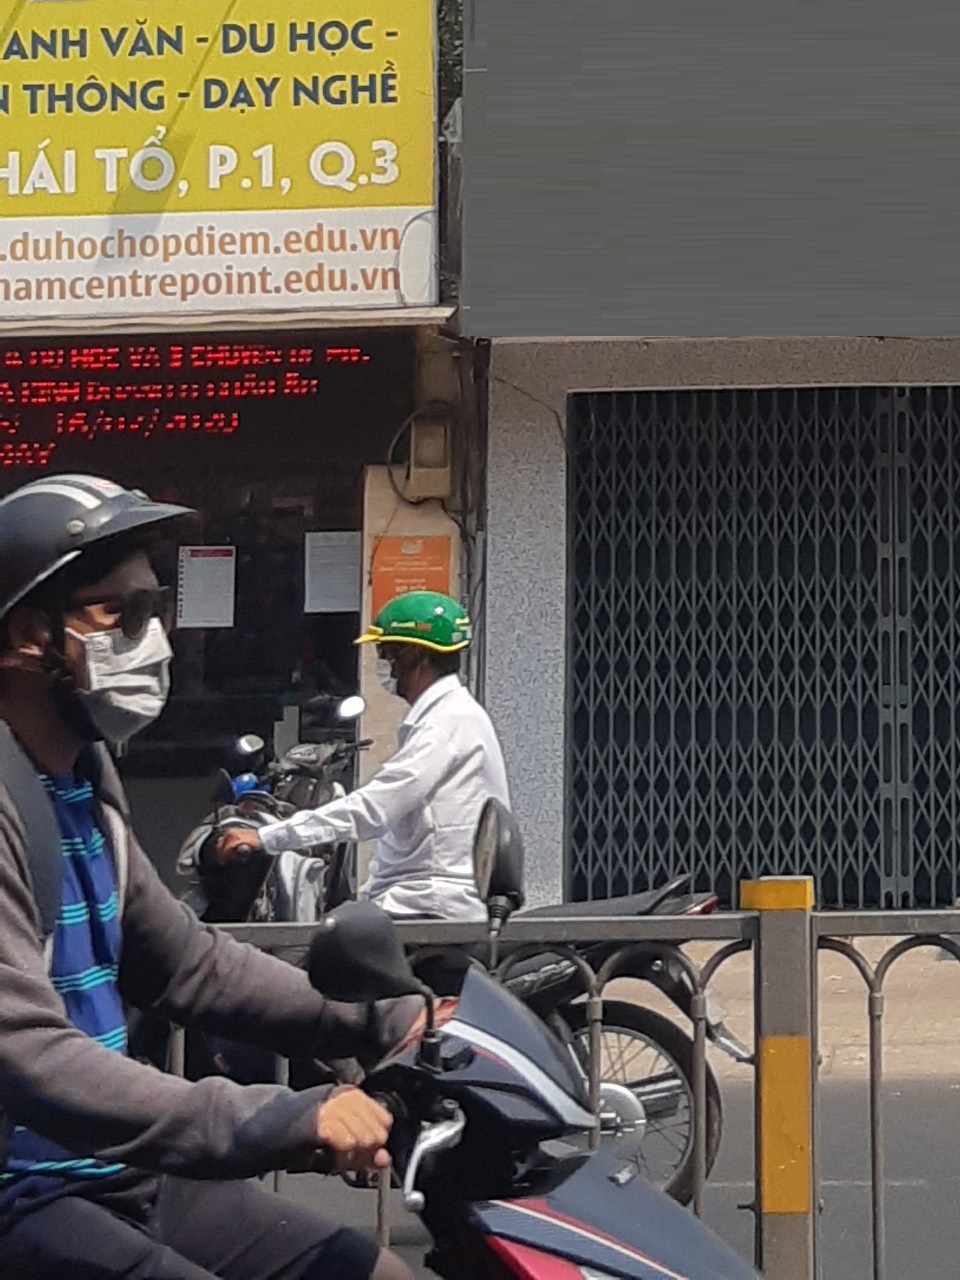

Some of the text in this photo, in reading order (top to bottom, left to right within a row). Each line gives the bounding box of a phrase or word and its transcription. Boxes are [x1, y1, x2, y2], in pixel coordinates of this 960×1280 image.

[3, 28, 88, 60] ANH
[100, 17, 184, 58] VĂN
[222, 22, 275, 55] DU
[289, 19, 374, 57] HỌC
[22, 74, 165, 115] THÔNG
[203, 77, 281, 115] DẠY
[292, 59, 398, 107] NGHỀ
[94, 124, 189, 199] TỔ,
[208, 143, 292, 197] P.1,
[308, 139, 400, 192] Q.3
